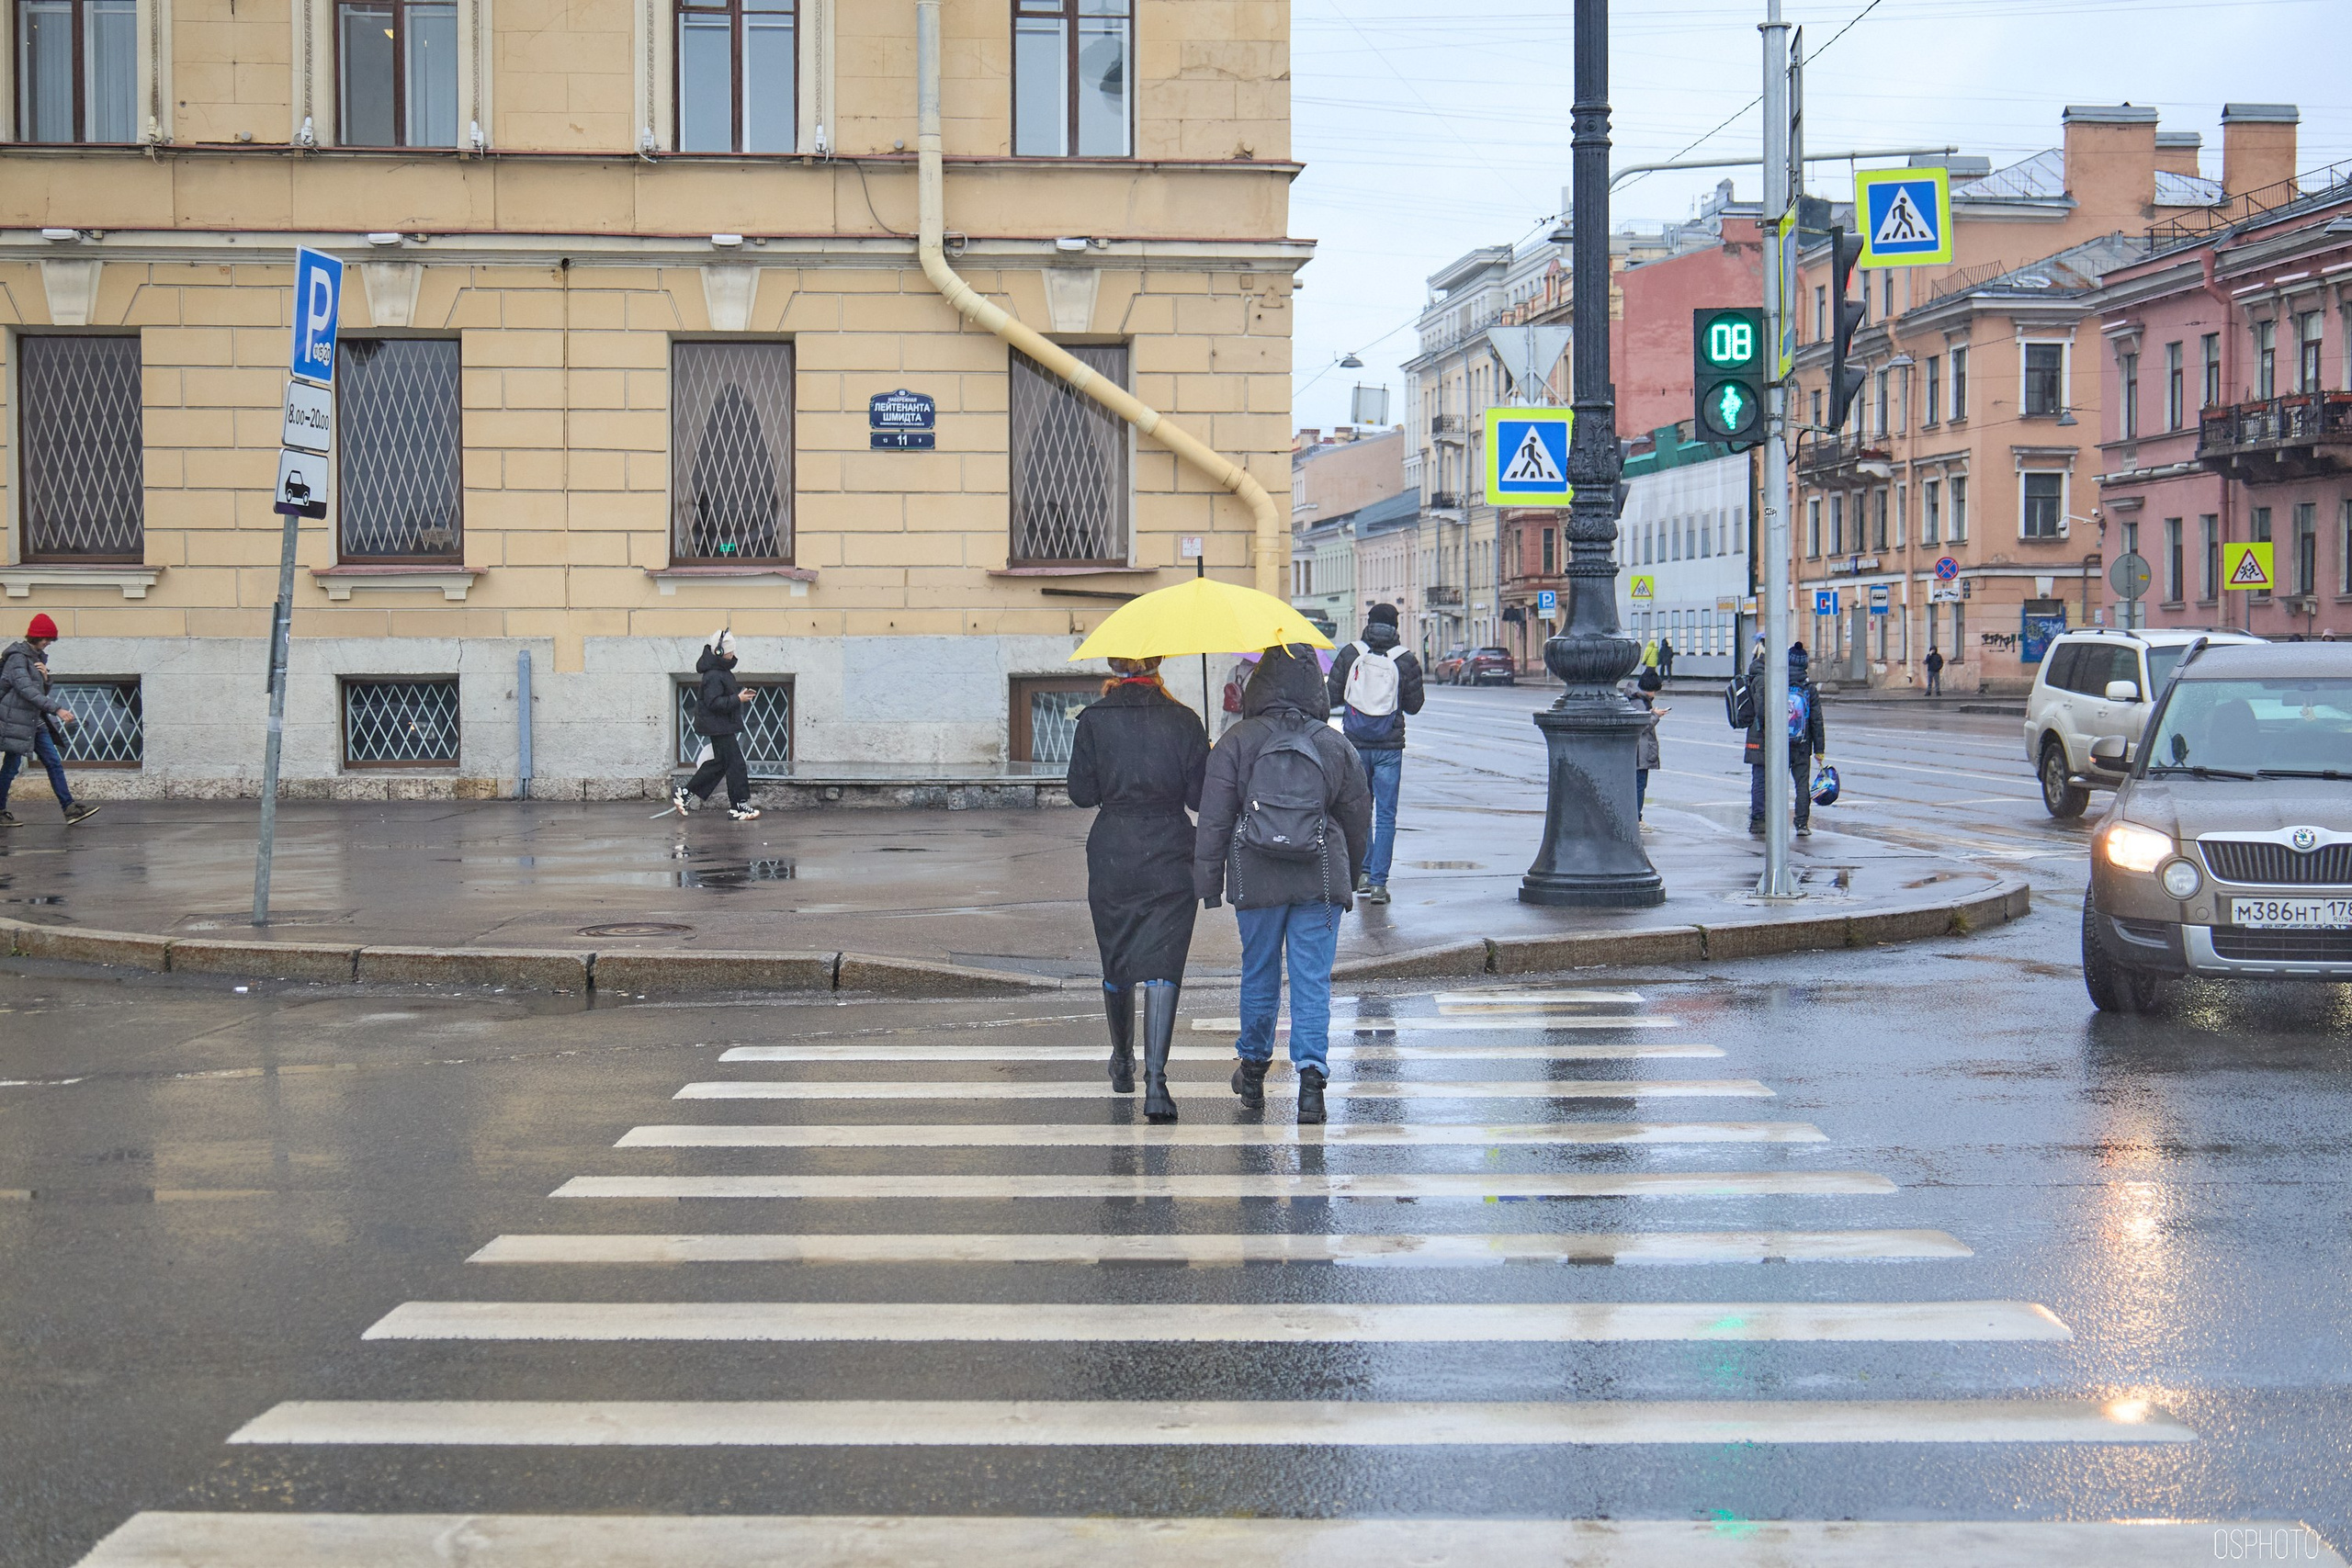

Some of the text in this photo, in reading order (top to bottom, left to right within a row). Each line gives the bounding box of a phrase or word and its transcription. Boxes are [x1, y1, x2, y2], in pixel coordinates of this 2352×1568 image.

[305, 265, 333, 363] P
[1711, 323, 1752, 361] 08
[323, 347, 331, 361] 20
[874, 402, 930, 412] ЛЕЙТЕНАНТА
[883, 412, 922, 423] ШМИДТА
[897, 434, 908, 446] 11
[1542, 592, 1553, 608] P
[2237, 902, 2321, 922] М386НТ
